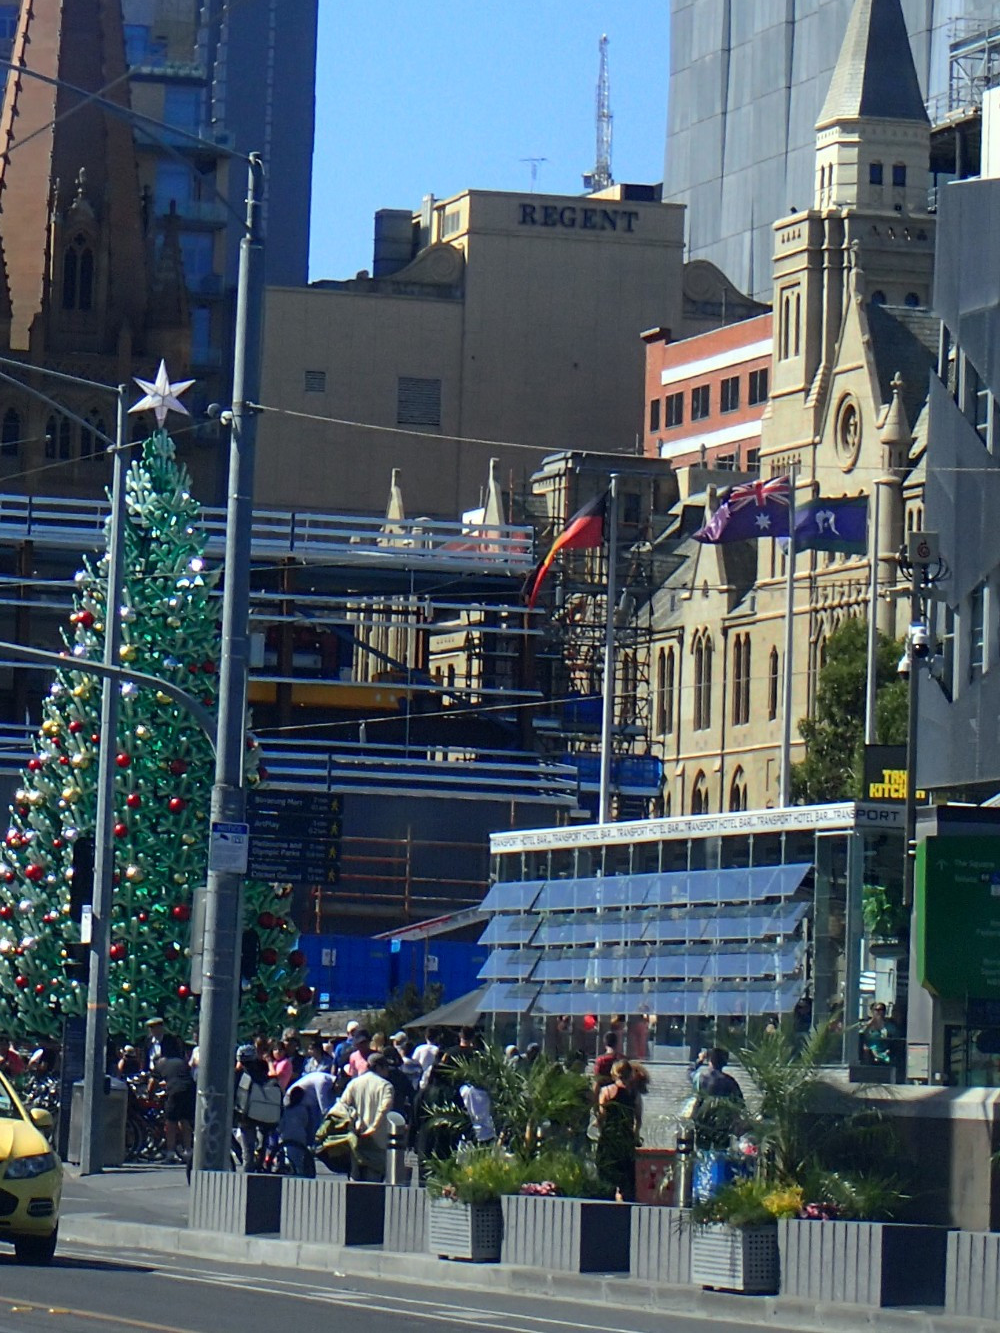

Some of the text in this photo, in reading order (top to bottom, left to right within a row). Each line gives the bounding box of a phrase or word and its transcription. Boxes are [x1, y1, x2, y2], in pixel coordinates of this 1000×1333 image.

[518, 203, 639, 232] REGENT
[520, 835, 536, 846] HOTEL
[552, 831, 581, 842] TRANSPORT
[583, 830, 599, 841] HOTEL
[617, 826, 648, 837] TRANSPORT
[649, 824, 666, 835] HOTEL
[684, 820, 718, 832] TRANSPORT
[720, 818, 738, 829] HOTEL
[757, 813, 792, 825] TRANSPORT
[794, 812, 814, 823] HOTEL
[834, 809, 899, 822] TRANSPORT
